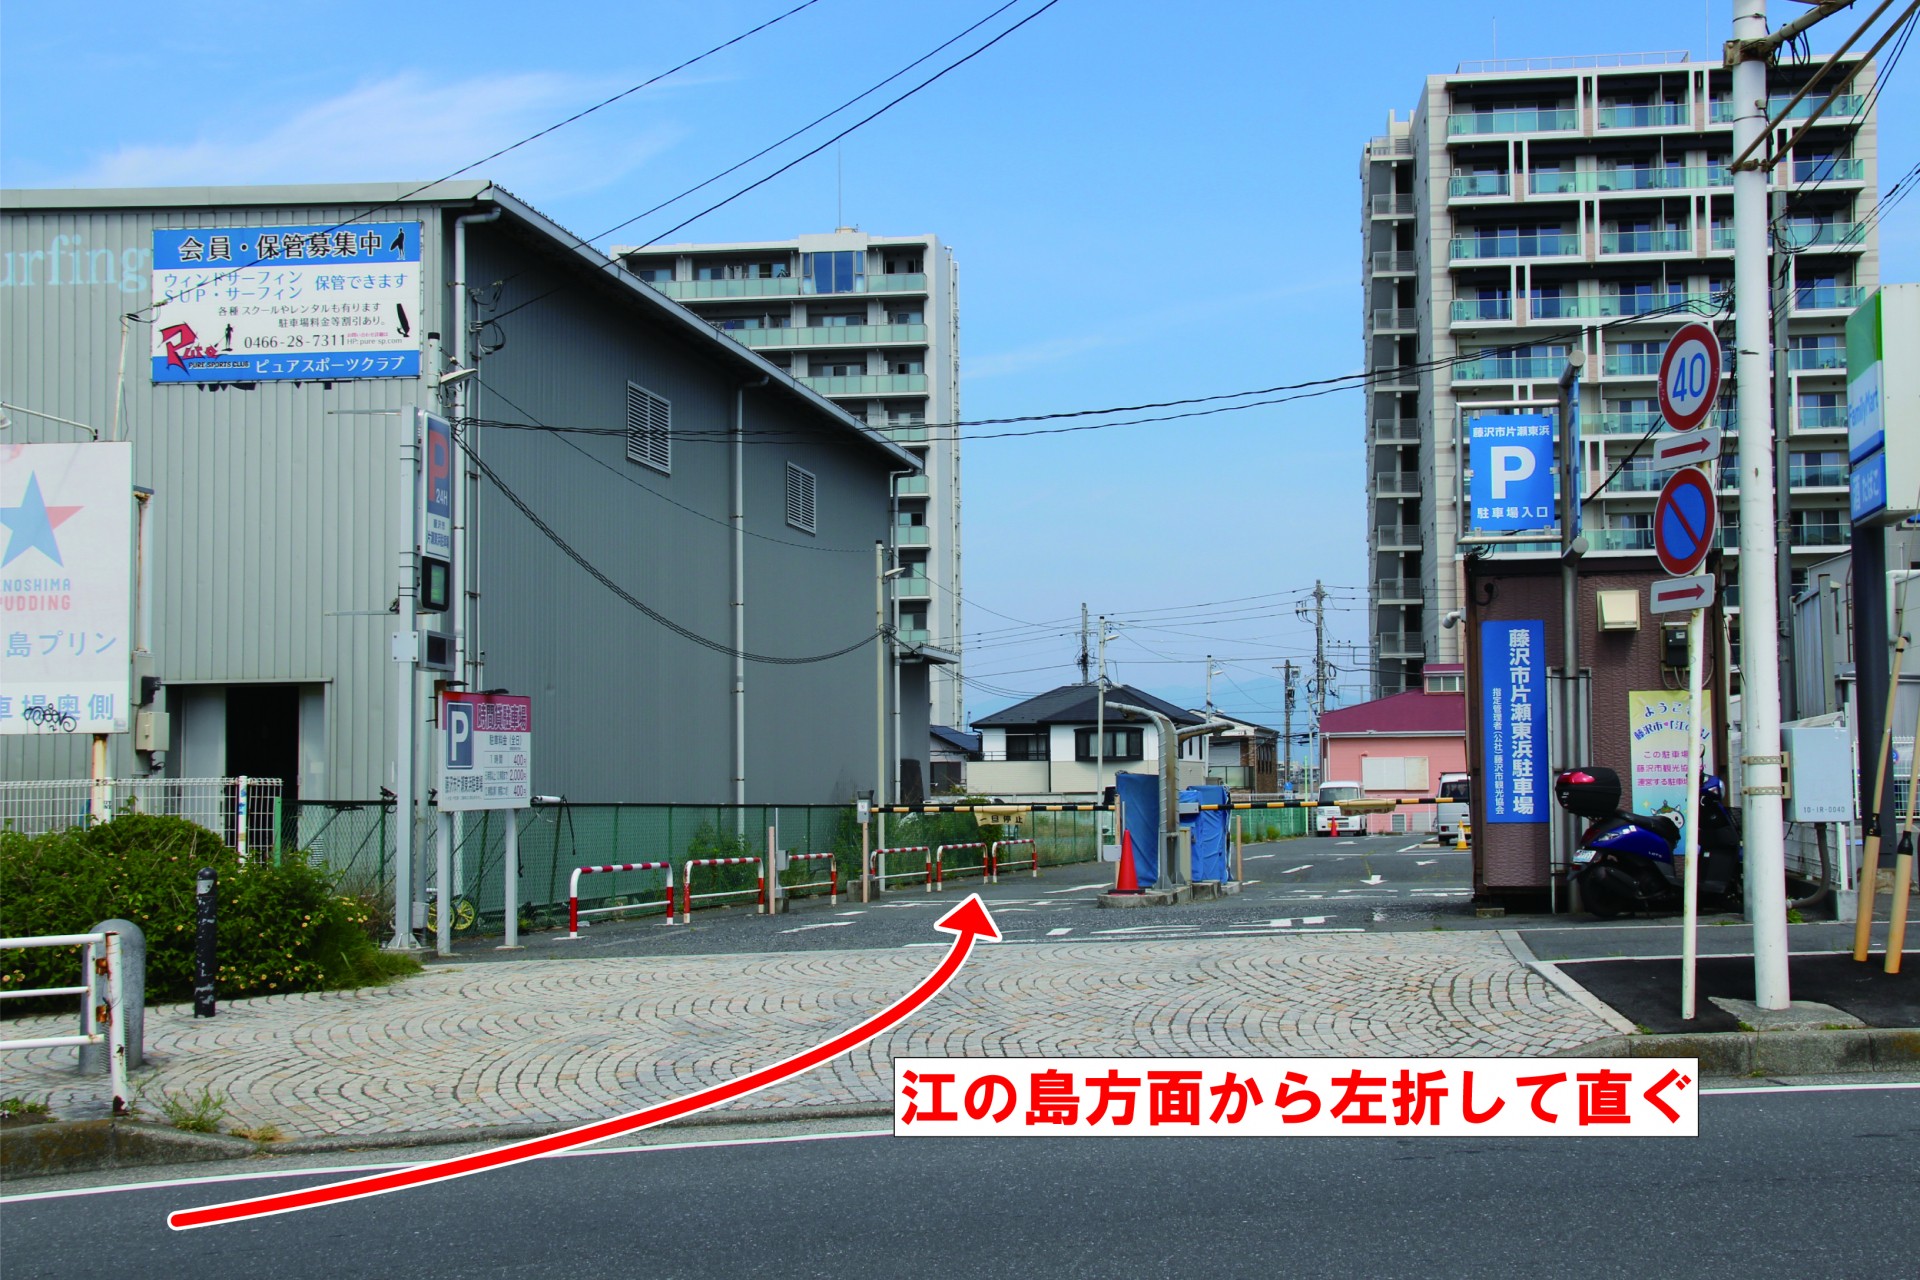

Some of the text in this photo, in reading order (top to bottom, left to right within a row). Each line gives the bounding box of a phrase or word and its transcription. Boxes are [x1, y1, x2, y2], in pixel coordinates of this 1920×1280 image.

[179, 230, 382, 262] 会員・保管募集中
[315, 273, 408, 291] 保管できます
[244, 334, 346, 349] 0466-28-7311
[256, 355, 405, 373] ピュアスポーツクラブ
[1672, 352, 1706, 402] 40
[1472, 425, 1550, 438] 藤沢市片瀬東浜
[429, 429, 449, 502] P
[1490, 445, 1536, 499] P
[435, 488, 448, 506] 24H
[1477, 506, 1548, 519] 駐車場入口
[0, 594, 71, 611] UDDING
[1509, 629, 1535, 815] 藤沢市片瀬東浜駐車場
[451, 711, 469, 761] P
[980, 815, 1023, 823] 一旦停止
